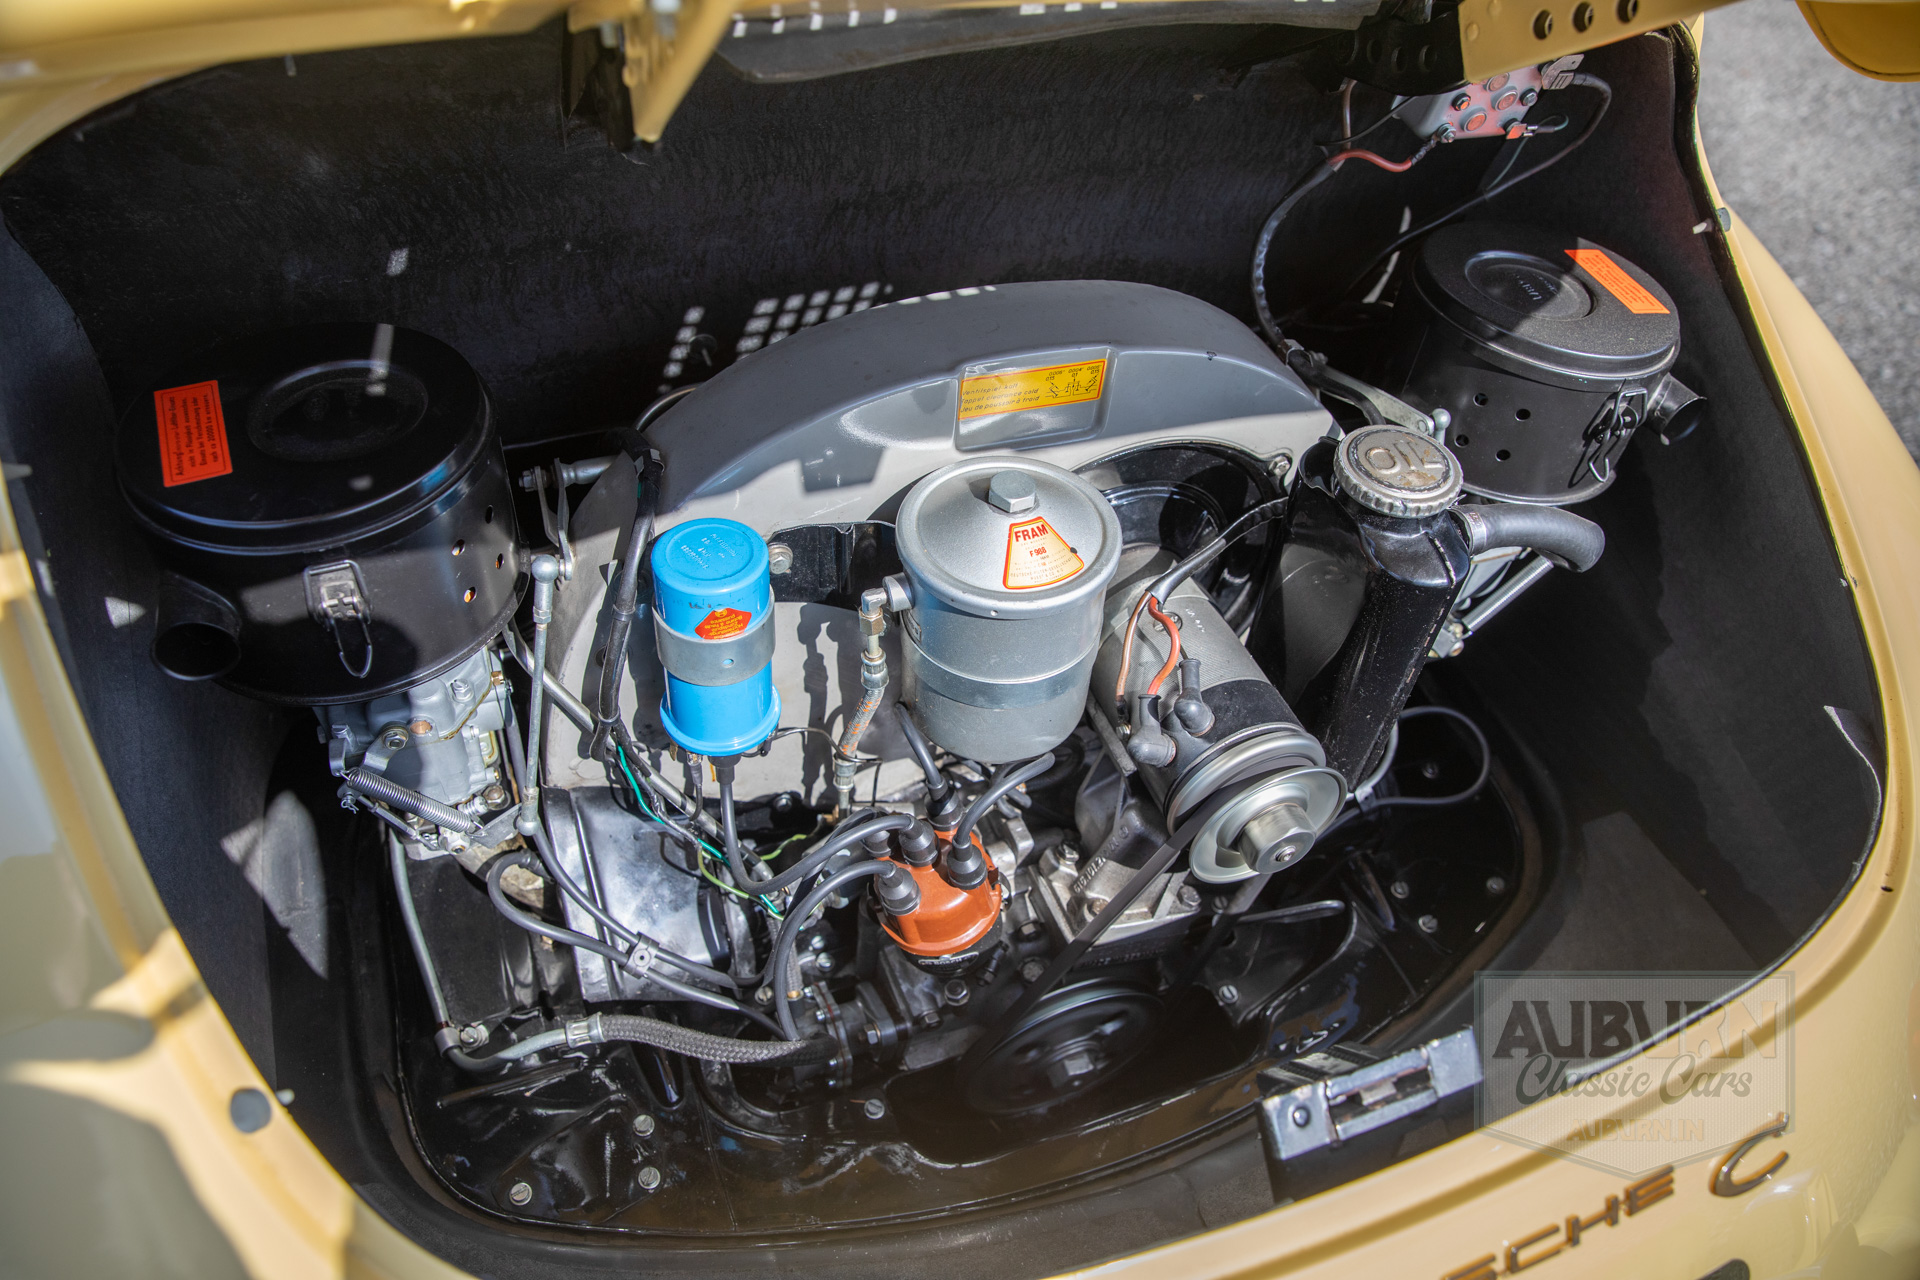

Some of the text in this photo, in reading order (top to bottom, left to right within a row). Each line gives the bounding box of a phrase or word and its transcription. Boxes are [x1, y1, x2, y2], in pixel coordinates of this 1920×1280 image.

[963, 386, 1001, 396] Ventilspiel
[986, 391, 1023, 400] clearance
[974, 403, 983, 411] de
[1366, 440, 1443, 475] OIL
[1014, 524, 1049, 543] FRAM
[1708, 1111, 1790, 1198] C
